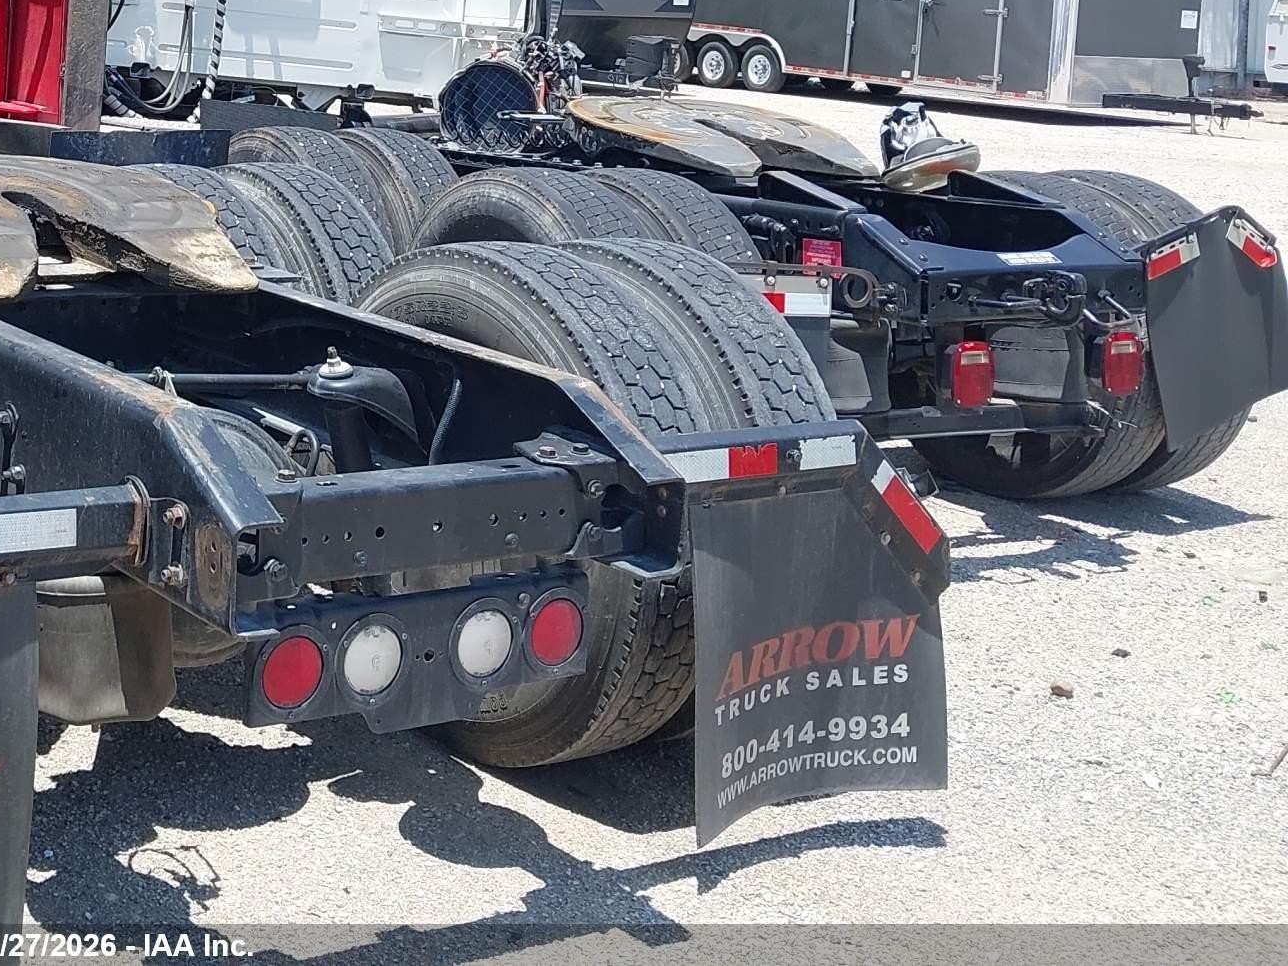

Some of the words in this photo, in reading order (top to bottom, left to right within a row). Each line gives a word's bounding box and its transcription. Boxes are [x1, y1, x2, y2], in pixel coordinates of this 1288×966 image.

[715, 613, 921, 702] ARROW
[714, 676, 791, 727] TRUCK
[805, 663, 910, 692] SALES
[716, 746, 918, 810] WWW.ARROWTRUCK.COM
[721, 712, 912, 779] 800-414-9934
